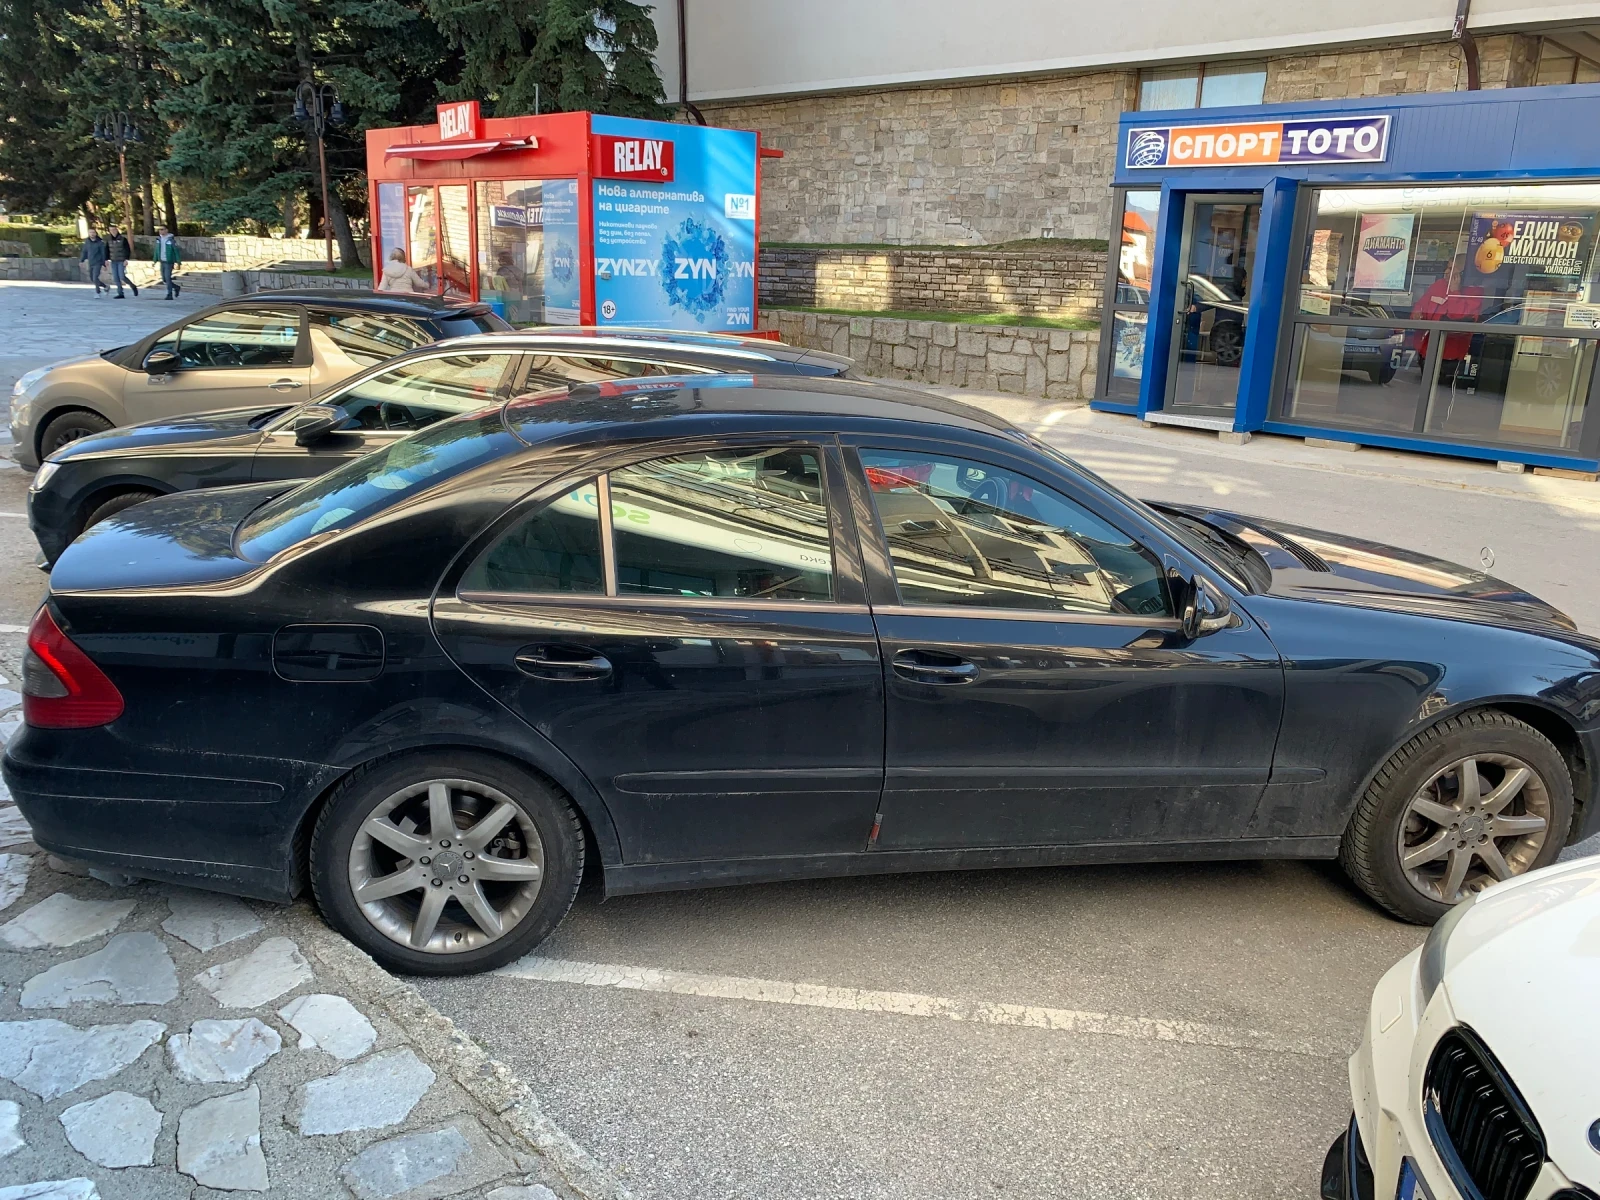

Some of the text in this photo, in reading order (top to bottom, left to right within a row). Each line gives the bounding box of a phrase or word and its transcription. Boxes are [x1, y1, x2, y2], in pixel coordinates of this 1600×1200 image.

[440, 103, 470, 140] RELAY
[1172, 125, 1379, 159] СПОРТ ТОТО
[614, 140, 663, 172] RELAY
[598, 184, 705, 203] Нова алтернатива
[598, 202, 670, 216] на цигарите
[598, 229, 610, 237] Без
[624, 230, 634, 239] без
[1513, 220, 1559, 242] ЕДИН
[599, 237, 610, 245] без
[1486, 250, 1493, 259] 6
[1508, 238, 1579, 259] МИЛИОН
[554, 257, 570, 268] ZYN
[1503, 255, 1545, 265] ШЕСТСТОТИН
[1553, 258, 1575, 267] ДЕСЕТ
[1573, 260, 1583, 275] ЕВРО
[674, 258, 716, 279] ZYN
[1544, 265, 1573, 275] ХИЛЯДИ
[602, 305, 616, 315] 18+
[726, 313, 750, 325] ZYN
